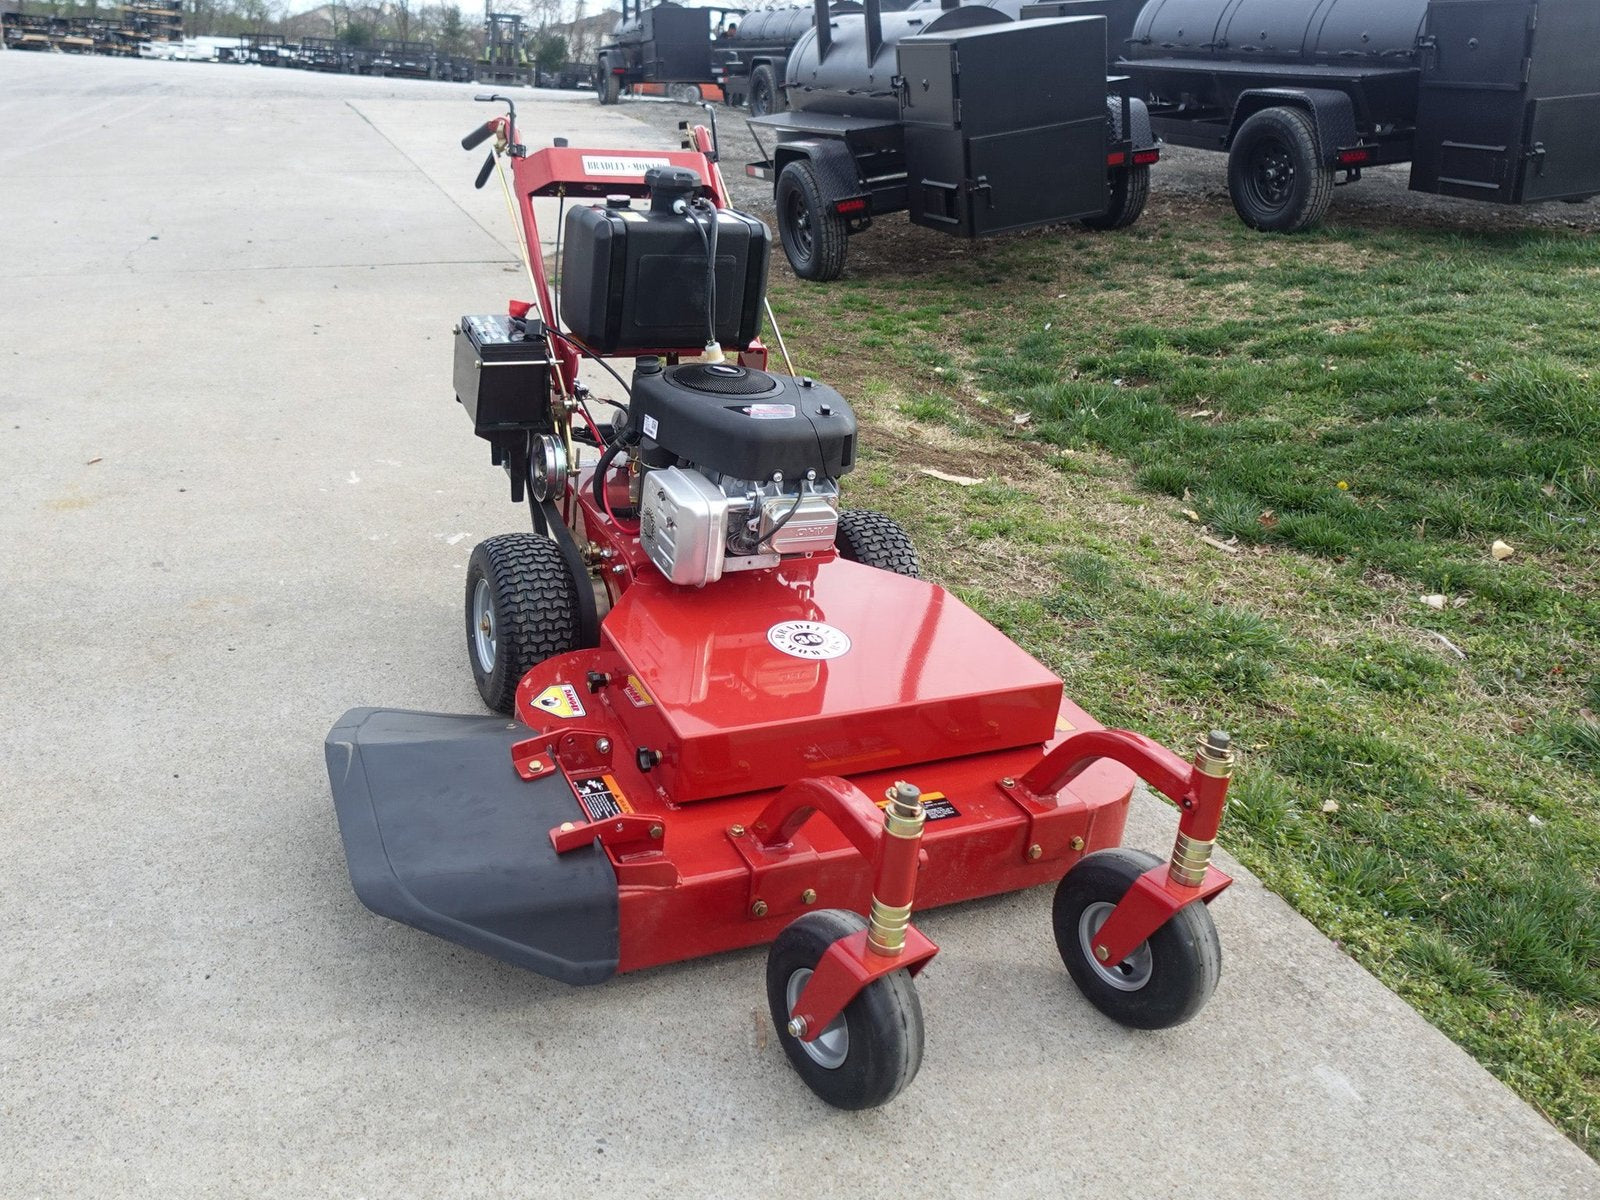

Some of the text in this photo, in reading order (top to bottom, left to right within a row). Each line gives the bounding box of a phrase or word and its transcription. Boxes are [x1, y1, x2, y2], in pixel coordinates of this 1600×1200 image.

[587, 161, 668, 171] BRADLEY MOWE
[564, 689, 580, 711] DANGER
